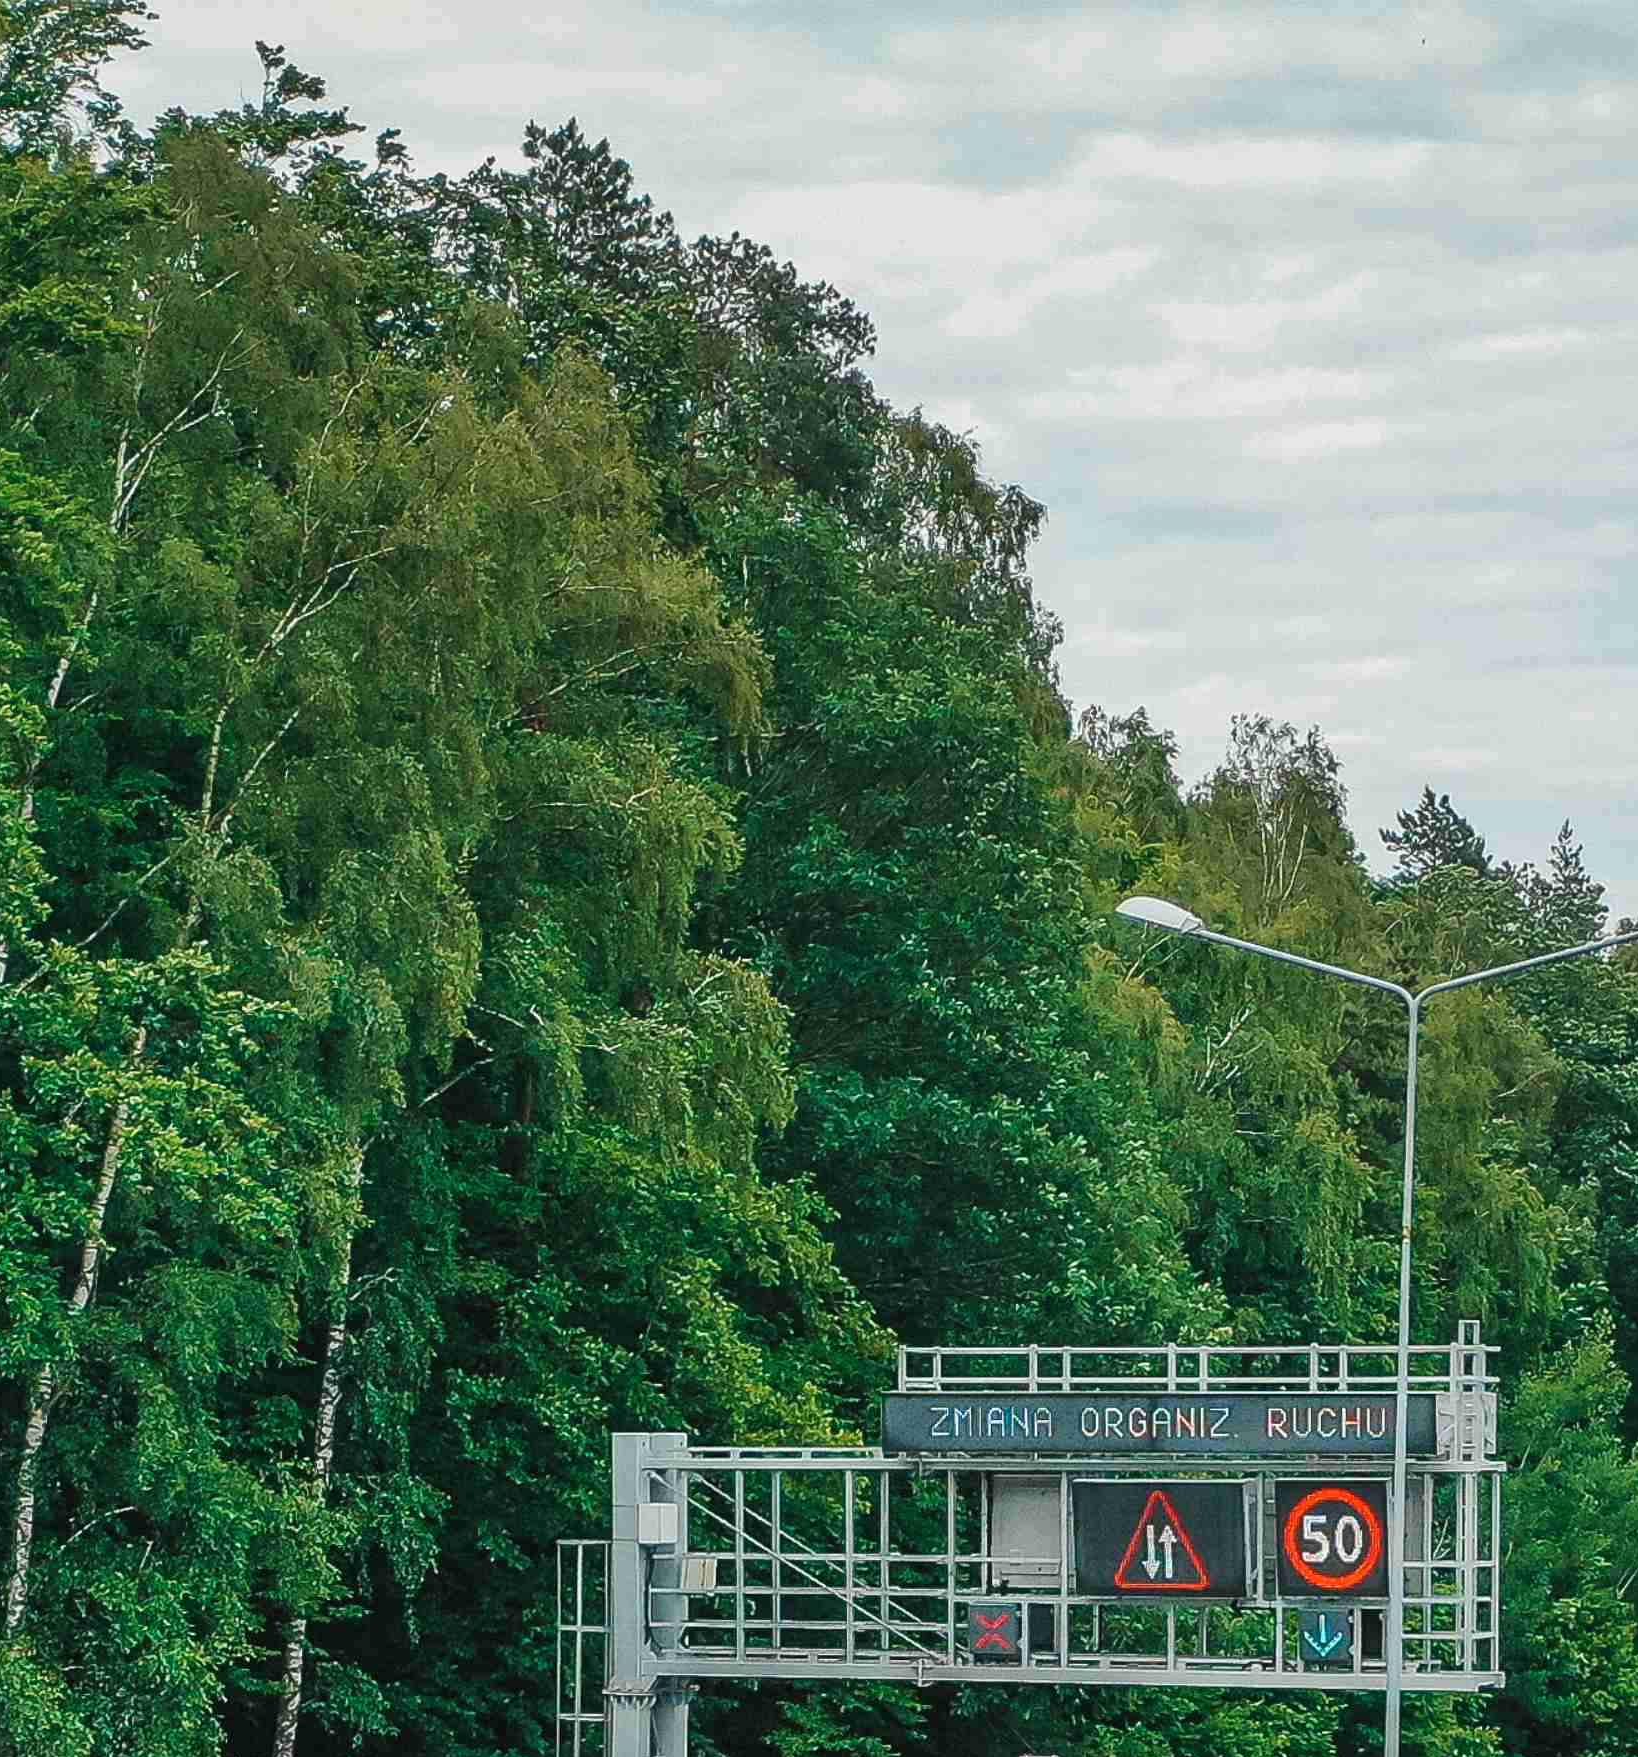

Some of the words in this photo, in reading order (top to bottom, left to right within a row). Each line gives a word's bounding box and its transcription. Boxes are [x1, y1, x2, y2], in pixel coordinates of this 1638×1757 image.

[930, 1407, 1052, 1437] ZMIANA
[1081, 1407, 1239, 1438] ORGANIZ.
[1267, 1407, 1386, 1438] RUCHU
[1302, 1515, 1362, 1562] 50
